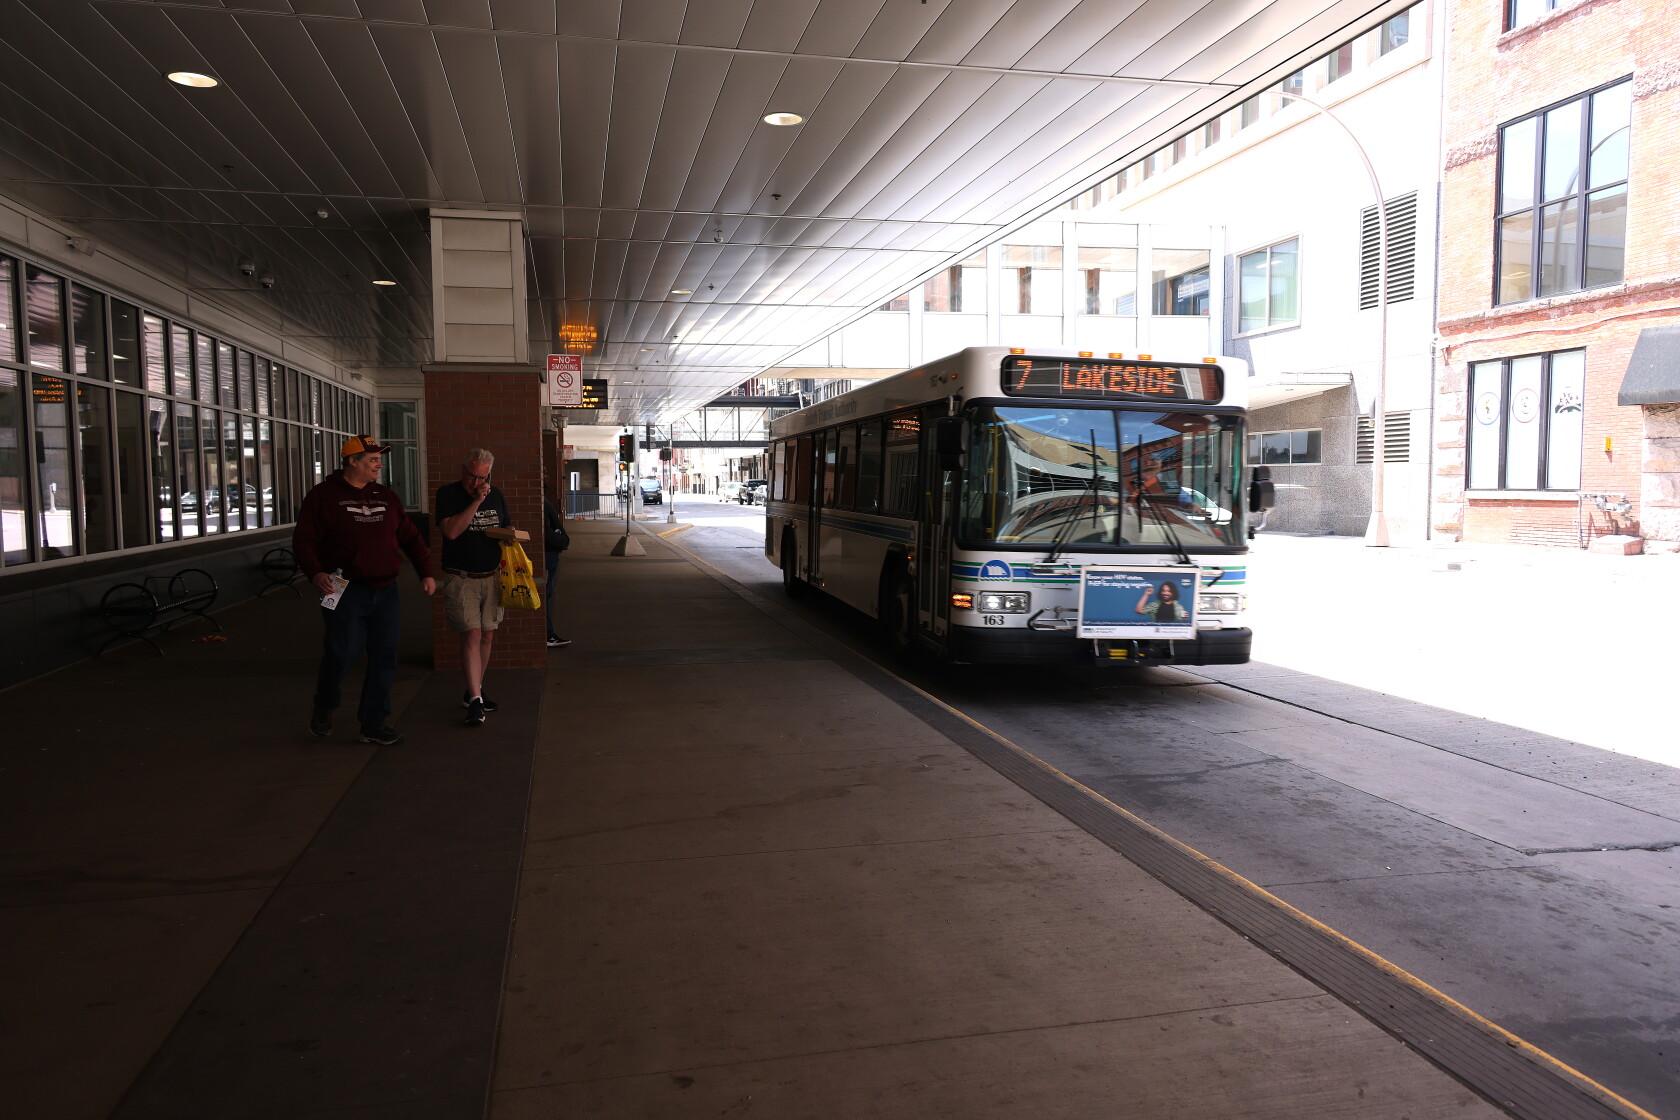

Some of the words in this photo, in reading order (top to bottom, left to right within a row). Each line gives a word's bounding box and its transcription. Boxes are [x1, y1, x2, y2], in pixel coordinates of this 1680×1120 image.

[558, 356, 570, 364] NO
[1016, 360, 1032, 389] 7
[1062, 363, 1176, 393] LAKESIDE
[982, 615, 1004, 625] 163
